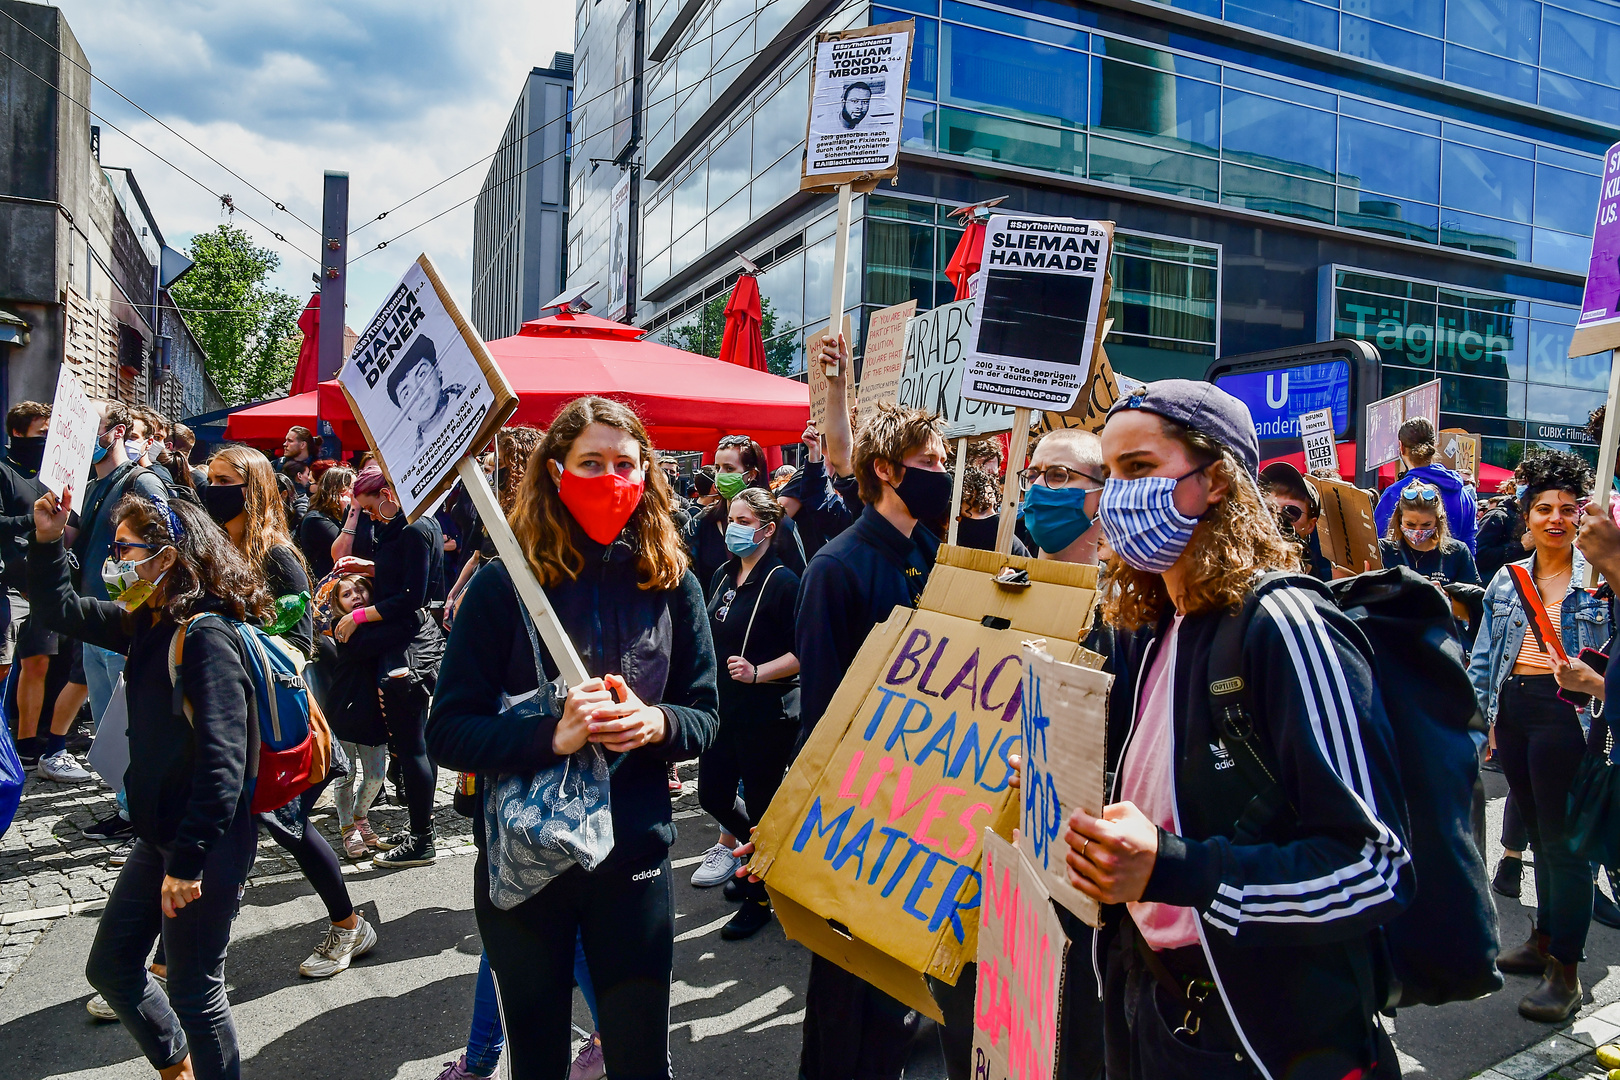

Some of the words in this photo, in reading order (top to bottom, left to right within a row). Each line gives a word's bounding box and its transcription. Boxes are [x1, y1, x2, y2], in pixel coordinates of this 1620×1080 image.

[832, 46, 892, 61] WILLIAM
[835, 38, 890, 50] #SayTheirNames
[829, 64, 889, 79] MBOBDA
[835, 132, 868, 140] gestorben
[815, 156, 887, 168] #AllBlackLivesMatter
[824, 149, 879, 158] Sicherheitsdienst
[1601, 202, 1618, 226] US.
[1010, 220, 1086, 234] #SayTheirNames
[1090, 229, 1099, 237] 32
[991, 232, 1100, 255] SLIEMAN
[989, 249, 1099, 273] HAMADE
[353, 286, 407, 357] #SayTheirNames
[871, 316, 878, 327] IF
[880, 314, 890, 325] YOU
[890, 311, 901, 322] ARE
[902, 307, 914, 318] NOT
[355, 290, 418, 376] HALIM
[869, 327, 884, 340] PART
[883, 325, 891, 336] OF
[890, 322, 902, 334] THE
[1346, 302, 1509, 366] Täglich
[365, 305, 426, 390] DENER
[866, 355, 877, 369] YOU
[876, 352, 888, 364] ARE
[888, 349, 903, 361] PART
[863, 370, 872, 381] OF
[872, 367, 883, 377] THE
[883, 362, 902, 375] PROBLE
[968, 369, 985, 377] von
[986, 369, 1002, 379] der
[1003, 372, 1048, 385] deutschen
[1050, 378, 1082, 390] Polizei
[975, 360, 993, 370] 2010
[995, 363, 1007, 372] zu
[1008, 365, 1030, 375] Tode
[1033, 369, 1077, 382] geprügelt
[976, 382, 1068, 403] #NoJusticeNoPeace
[1266, 372, 1289, 410] U
[418, 417, 455, 466] erschossen
[455, 400, 469, 417] von
[469, 383, 482, 400] der
[415, 434, 451, 477] deutschen
[449, 403, 475, 434] Polizei
[1306, 435, 1330, 449] BLACK
[414, 408, 485, 495] #NoJusticeNoPeace
[1309, 446, 1330, 459] LIVES
[1309, 457, 1332, 470] MATTER
[862, 685, 1023, 794] TRANS
[1214, 759, 1236, 771] adid
[1025, 756, 1062, 871] POP
[632, 867, 661, 882] adidas
[791, 795, 983, 946] MATTER
